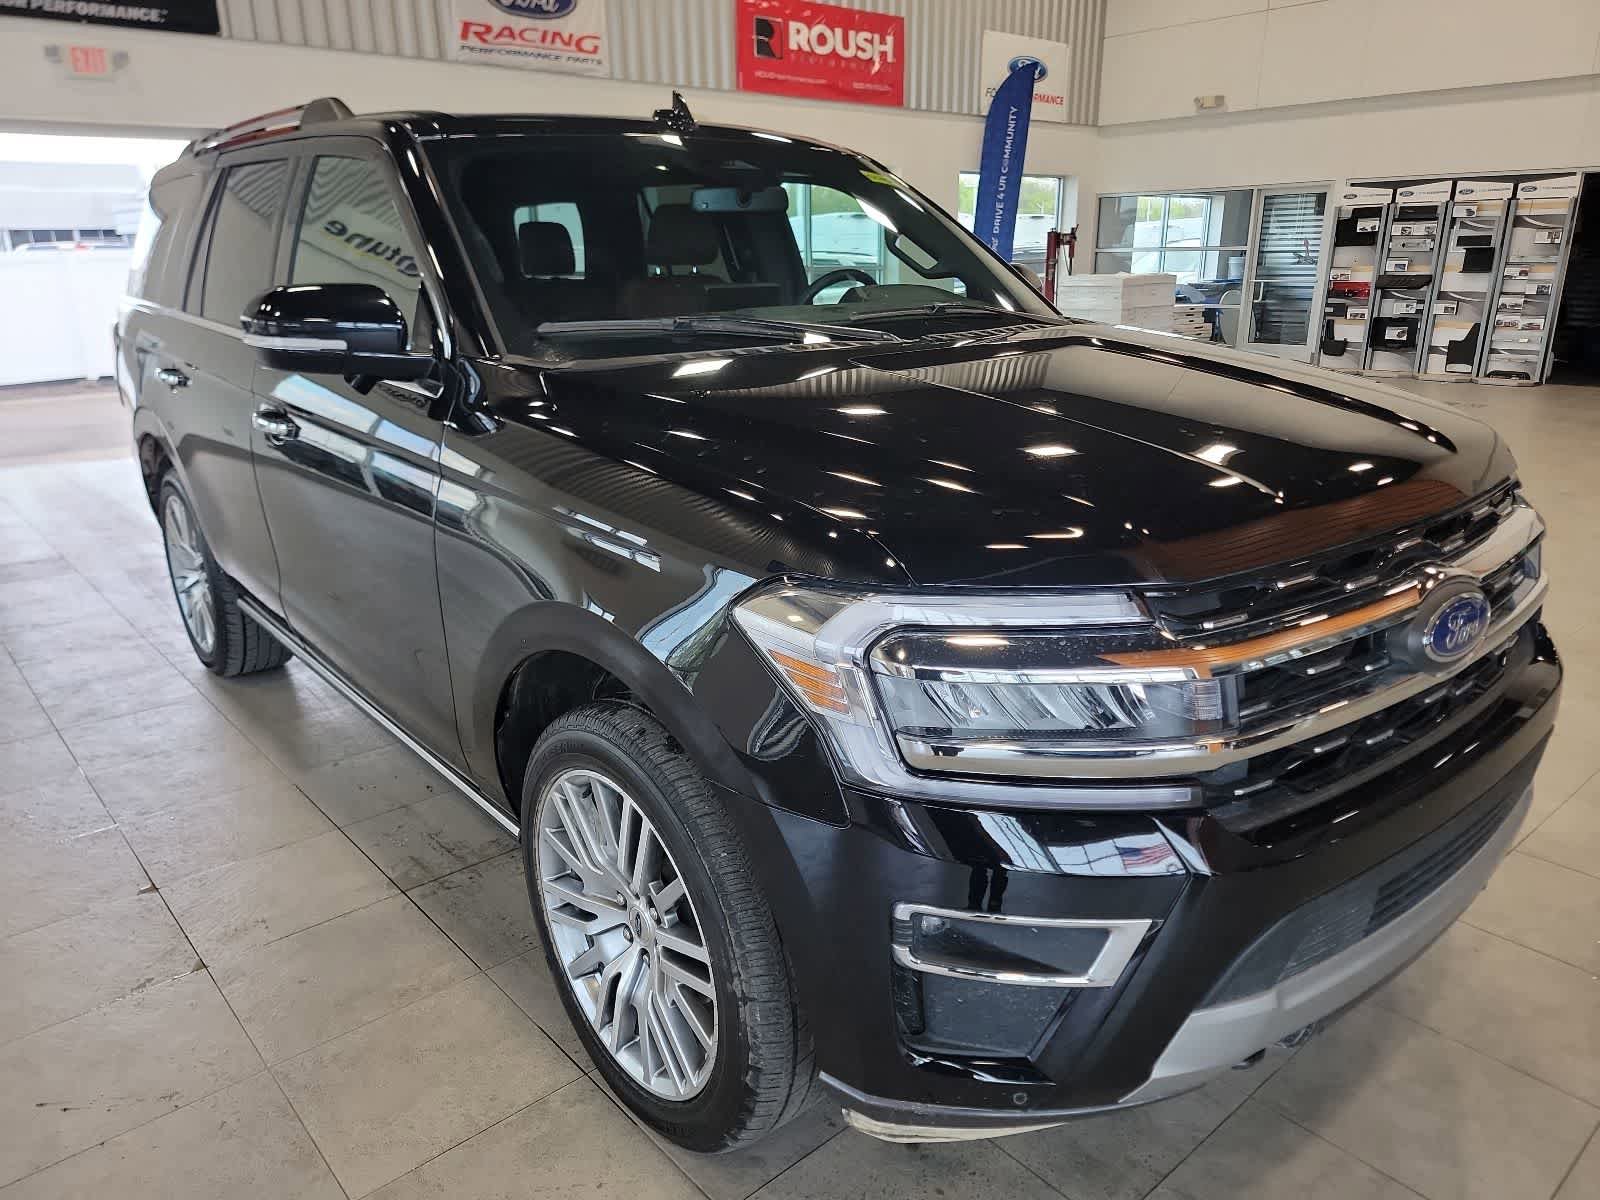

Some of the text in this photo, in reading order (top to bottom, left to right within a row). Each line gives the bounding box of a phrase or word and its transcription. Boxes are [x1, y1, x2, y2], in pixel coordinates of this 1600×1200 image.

[459, 21, 601, 54] RACING
[788, 20, 895, 64] ROUSH
[460, 45, 603, 65] PERFORMANCE PARTS
[1001, 106, 1019, 174] COMMUNITY
[999, 176, 1006, 190] UR
[992, 201, 1004, 233] DRIVE
